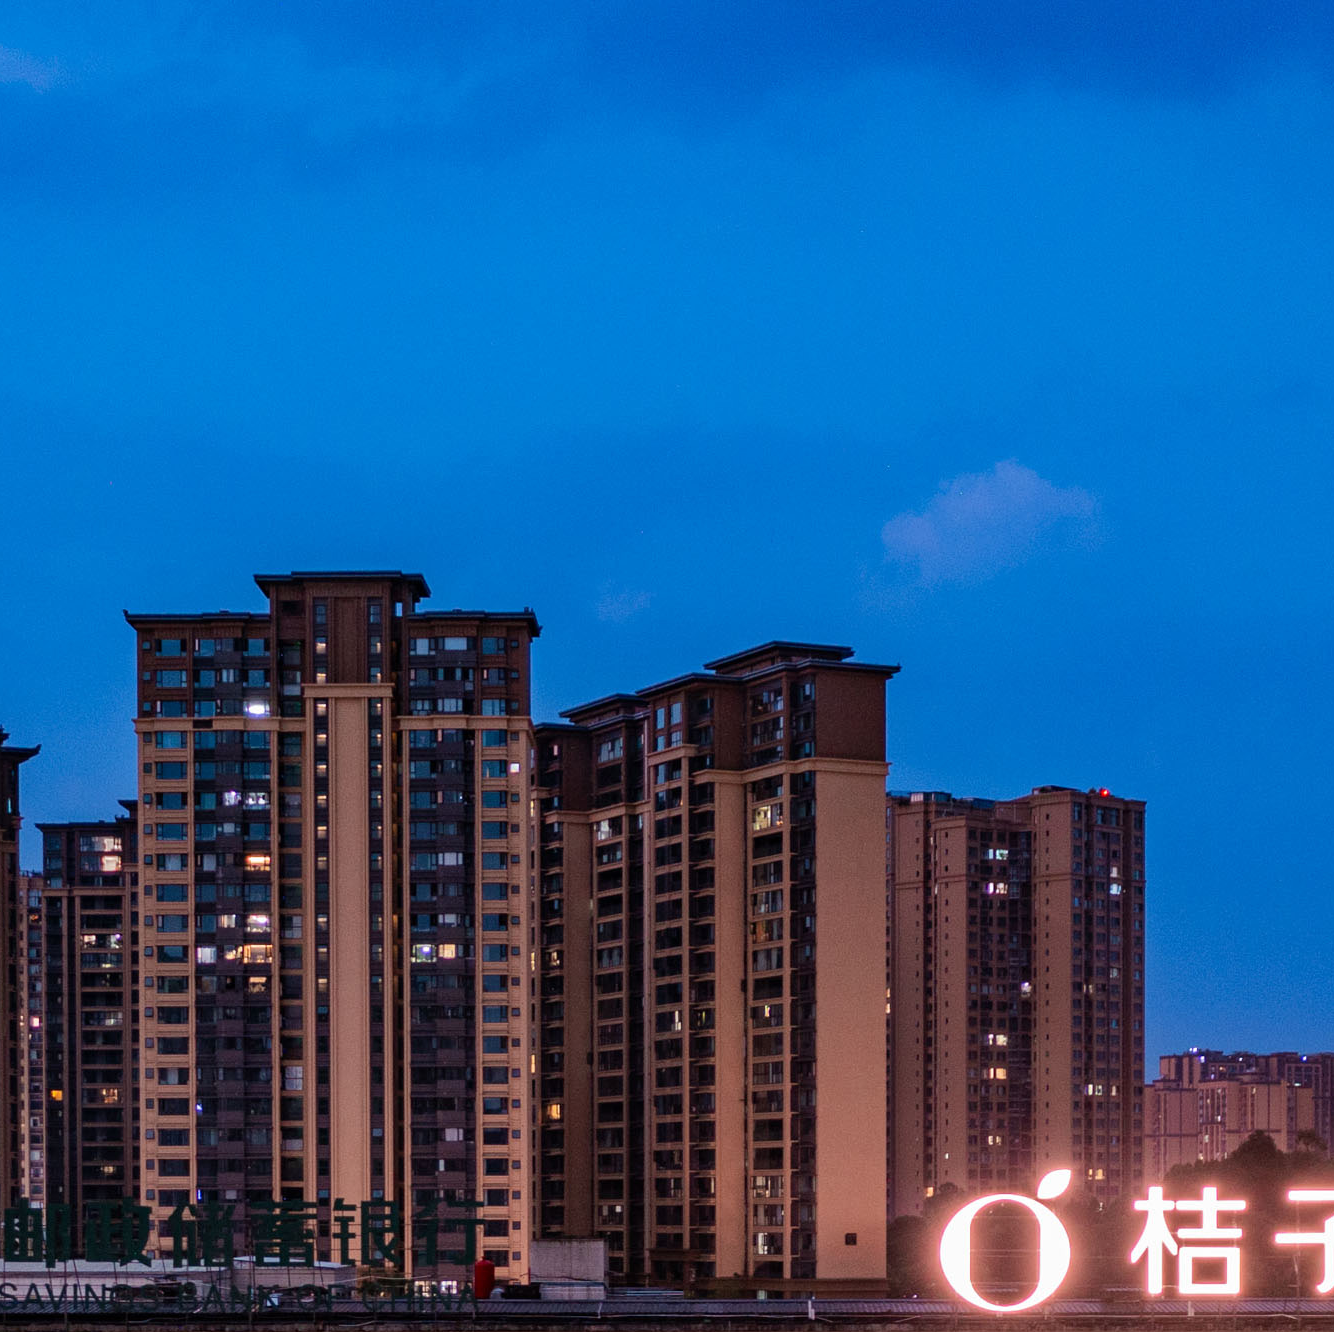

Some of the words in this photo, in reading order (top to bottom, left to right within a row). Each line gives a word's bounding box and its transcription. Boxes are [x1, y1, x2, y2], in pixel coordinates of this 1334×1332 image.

[179, 1282, 279, 1312] BANK
[297, 1283, 346, 1312] OF
[362, 1282, 478, 1312] CHINA
